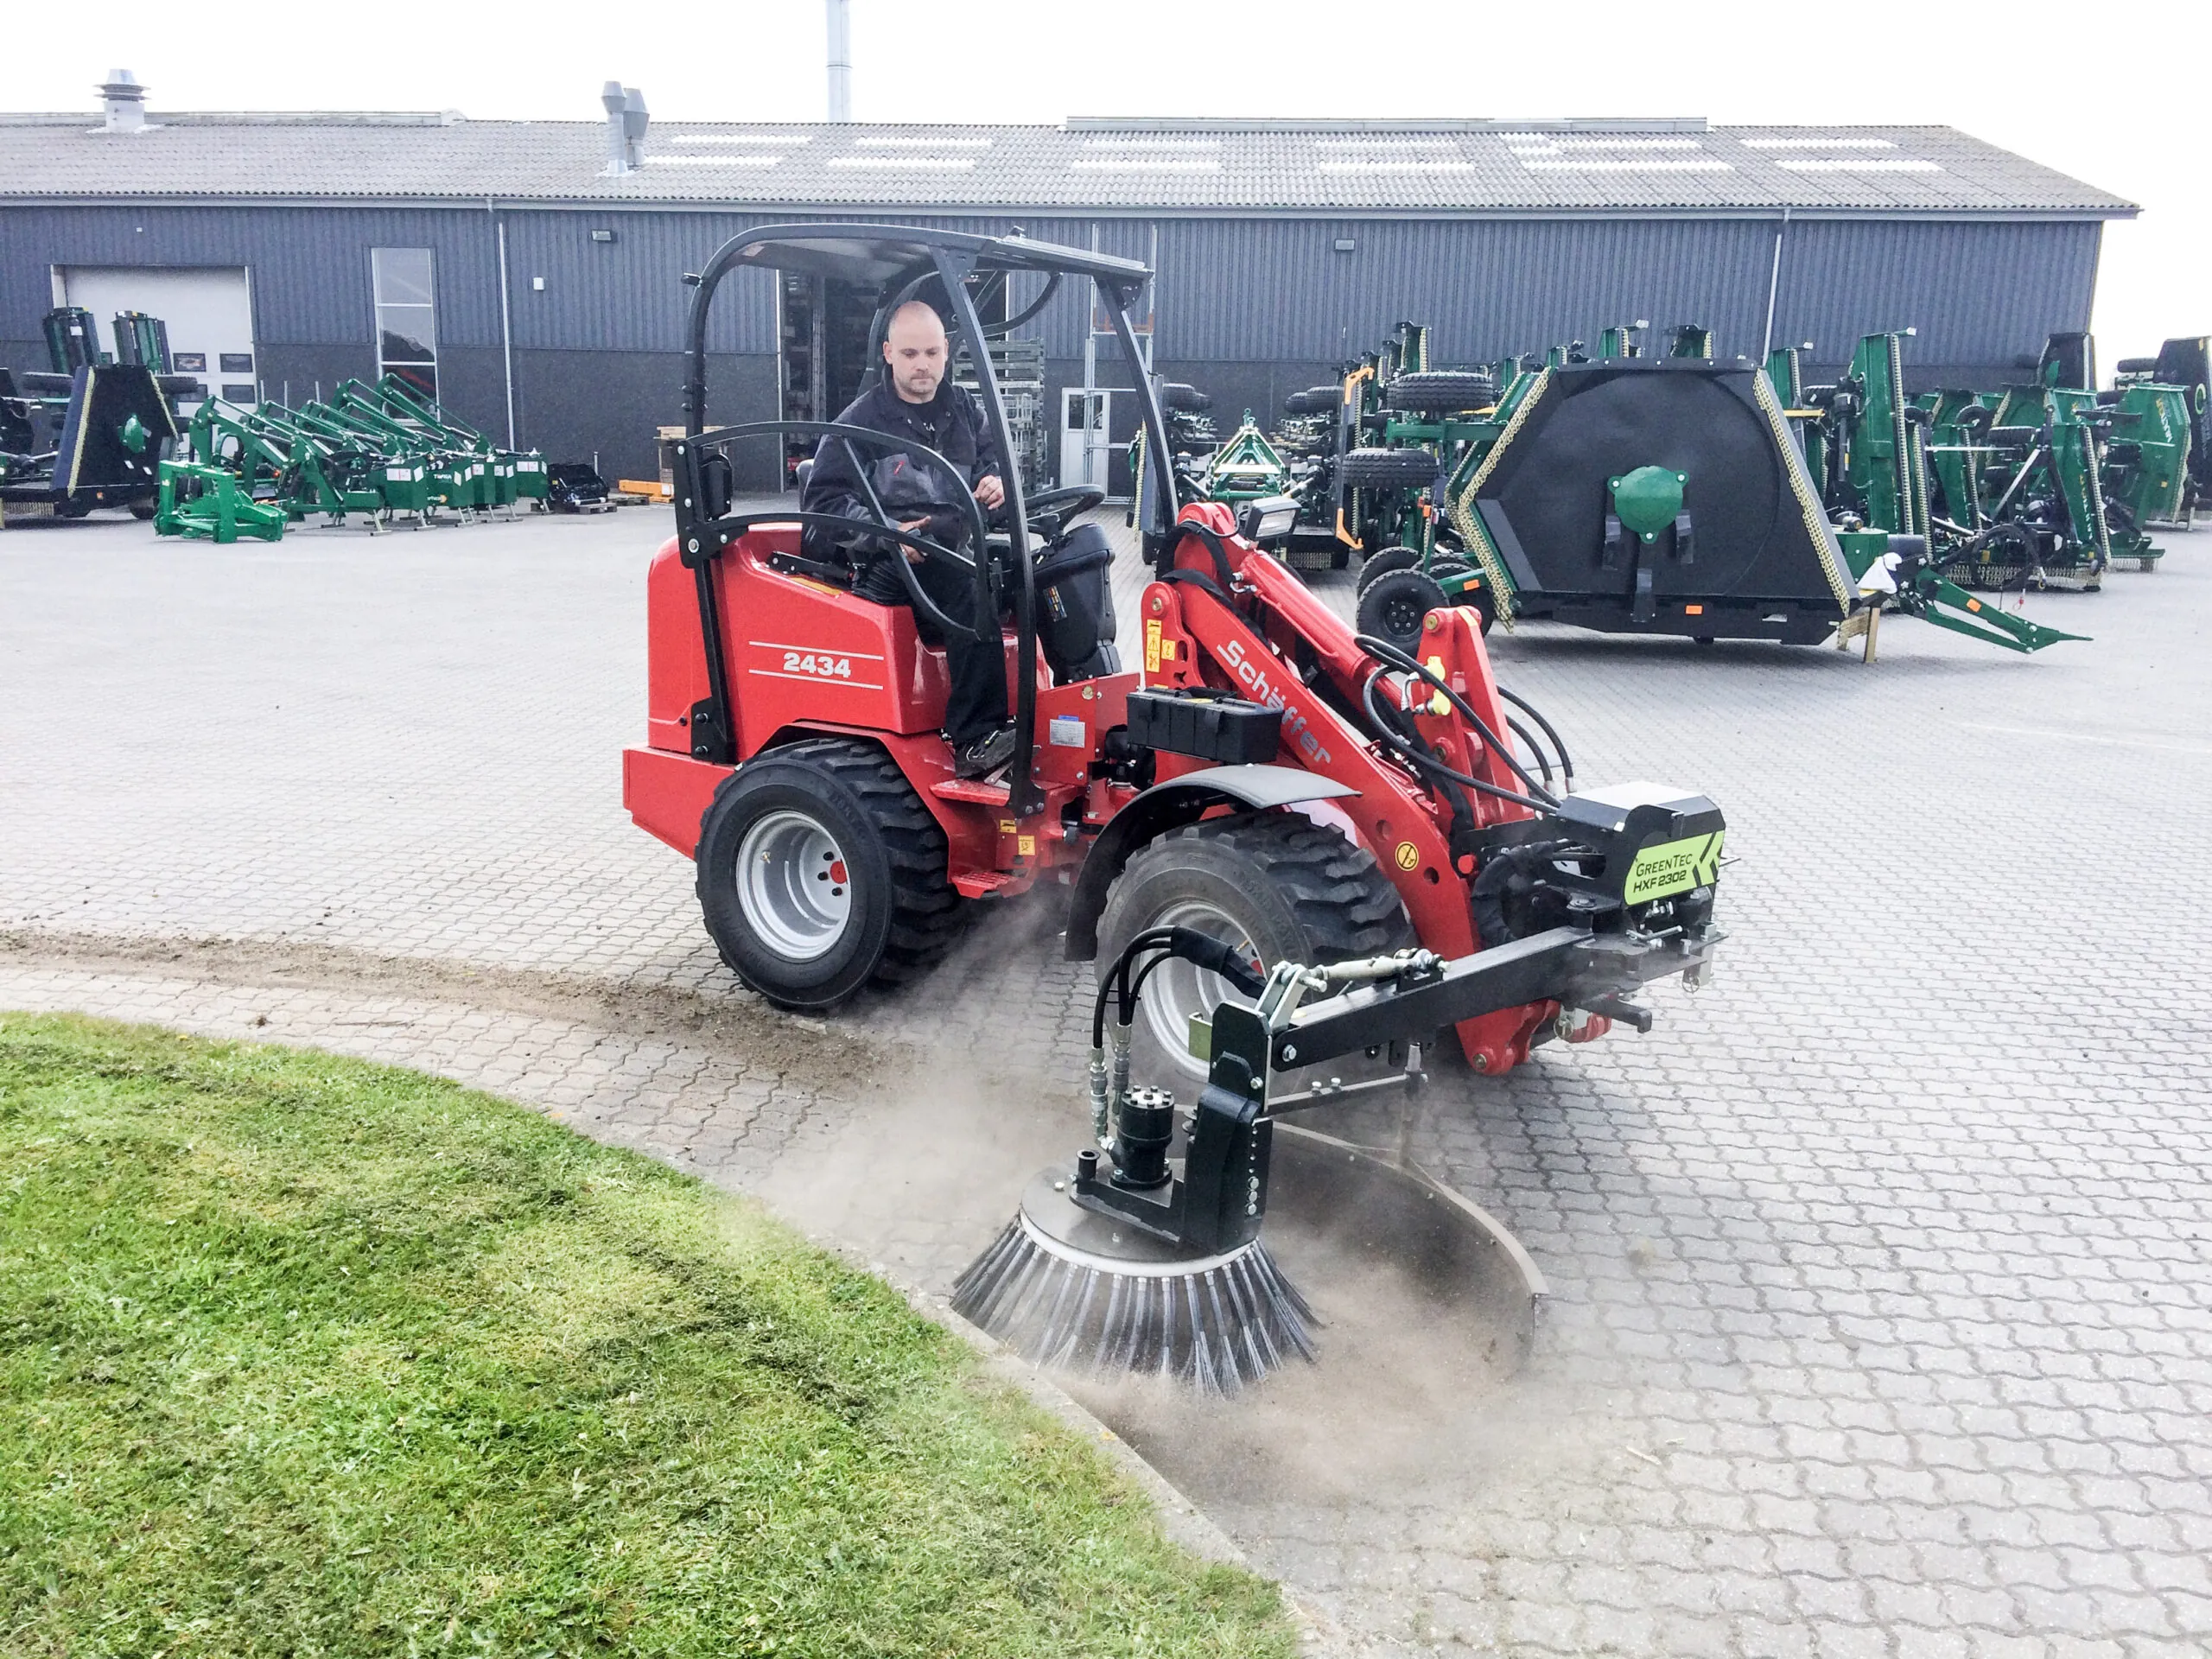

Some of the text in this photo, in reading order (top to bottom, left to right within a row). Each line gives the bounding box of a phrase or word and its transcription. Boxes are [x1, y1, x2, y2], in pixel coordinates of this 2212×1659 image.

[783, 652, 851, 678] 2434
[1217, 640, 1332, 764] Schäffer
[1633, 869, 1688, 893] HXF 2302
